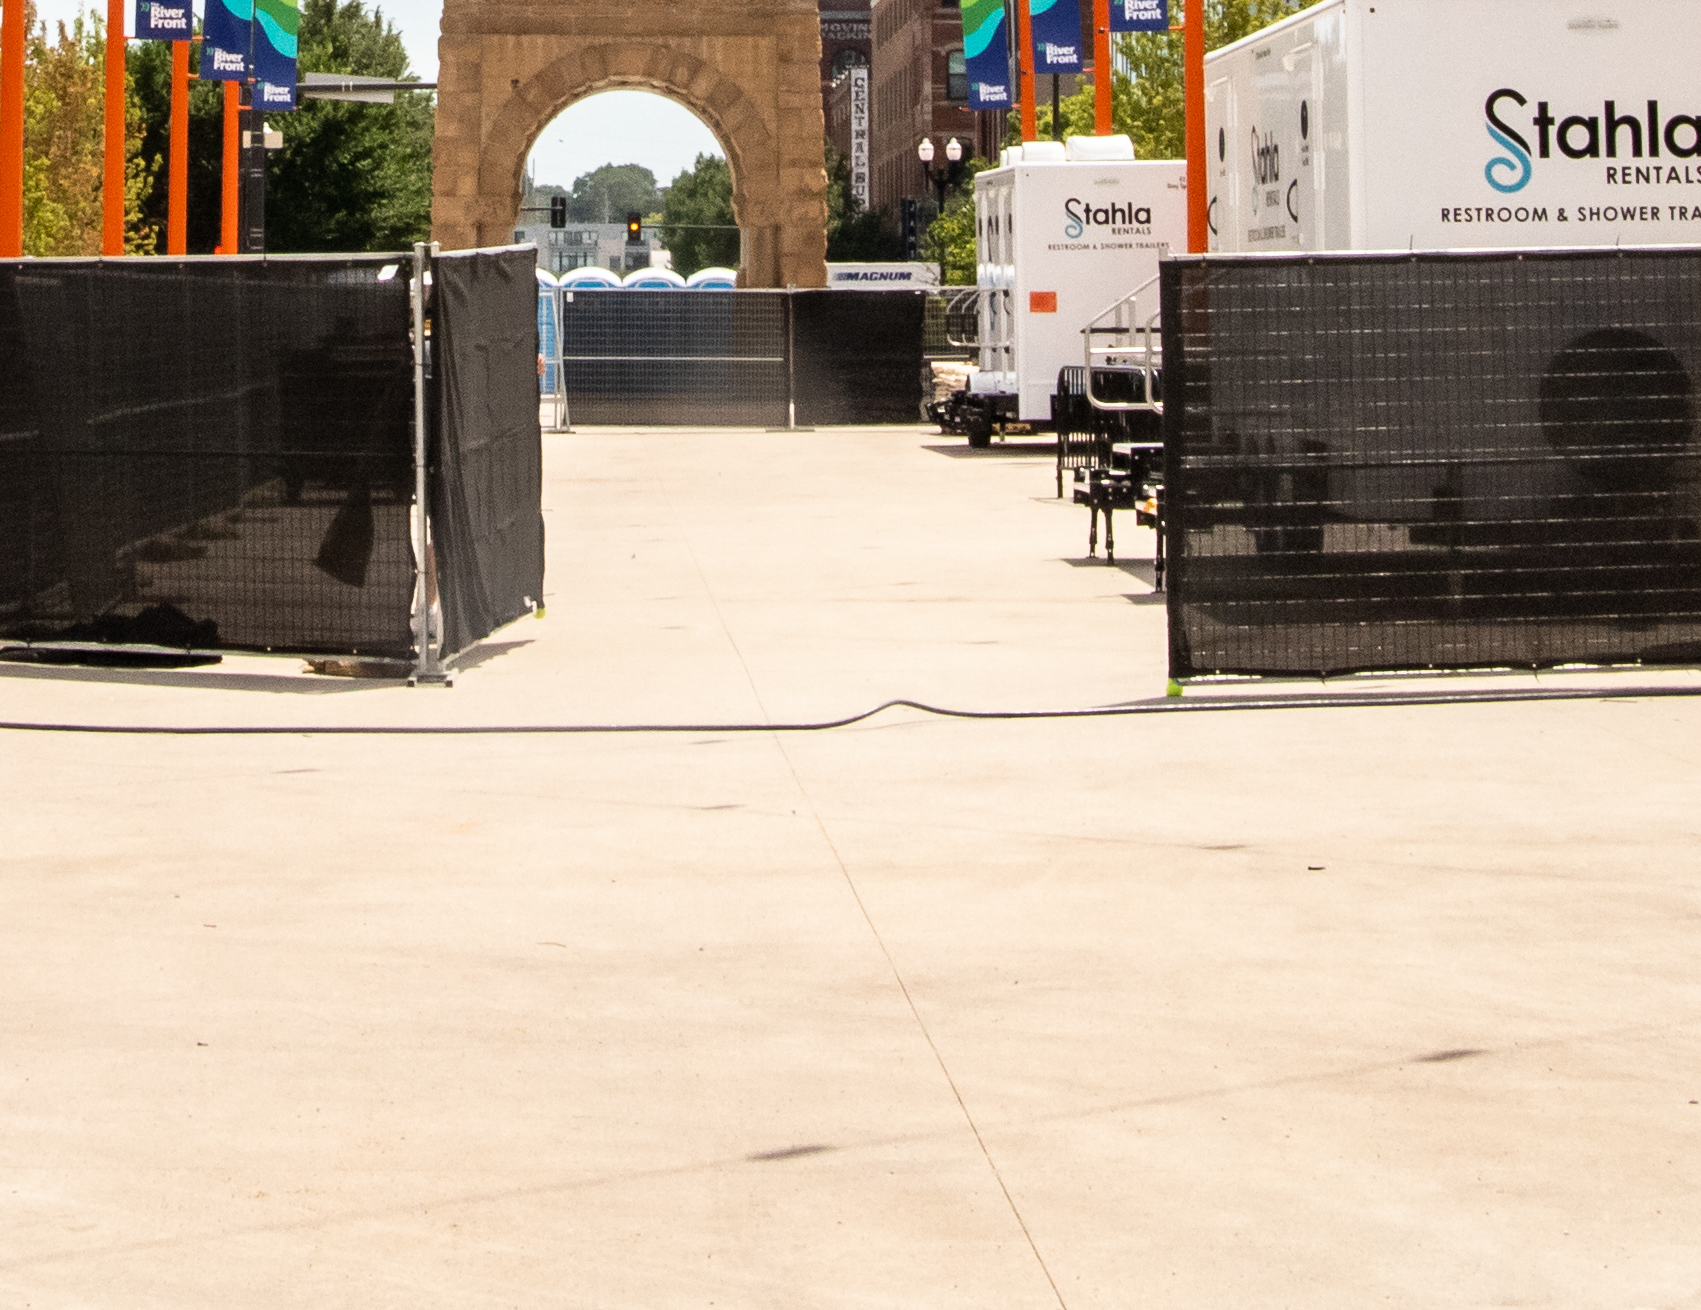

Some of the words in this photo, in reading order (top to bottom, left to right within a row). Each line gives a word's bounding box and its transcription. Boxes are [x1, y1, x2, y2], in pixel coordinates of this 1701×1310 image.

[151, 5, 184, 20] River
[1125, 8, 1162, 21] Front
[150, 17, 186, 29] Front
[1046, 45, 1075, 56] River
[214, 51, 243, 63] River
[1046, 53, 1078, 64] Front
[214, 61, 244, 72] Front
[264, 84, 290, 95] River
[979, 84, 1005, 94] River
[264, 93, 291, 102] Front
[979, 92, 1007, 102] Front
[854, 77, 866, 167] CENTRAL
[1065, 197, 1151, 239] Stahla
[1441, 207, 1548, 223] RESTROOM
[1557, 206, 1569, 222] &
[1577, 205, 1660, 222] SHOWER
[1111, 227, 1151, 236] RENTALS
[1135, 242, 1169, 250] TRAILERS
[846, 271, 912, 281] MAGNUM
